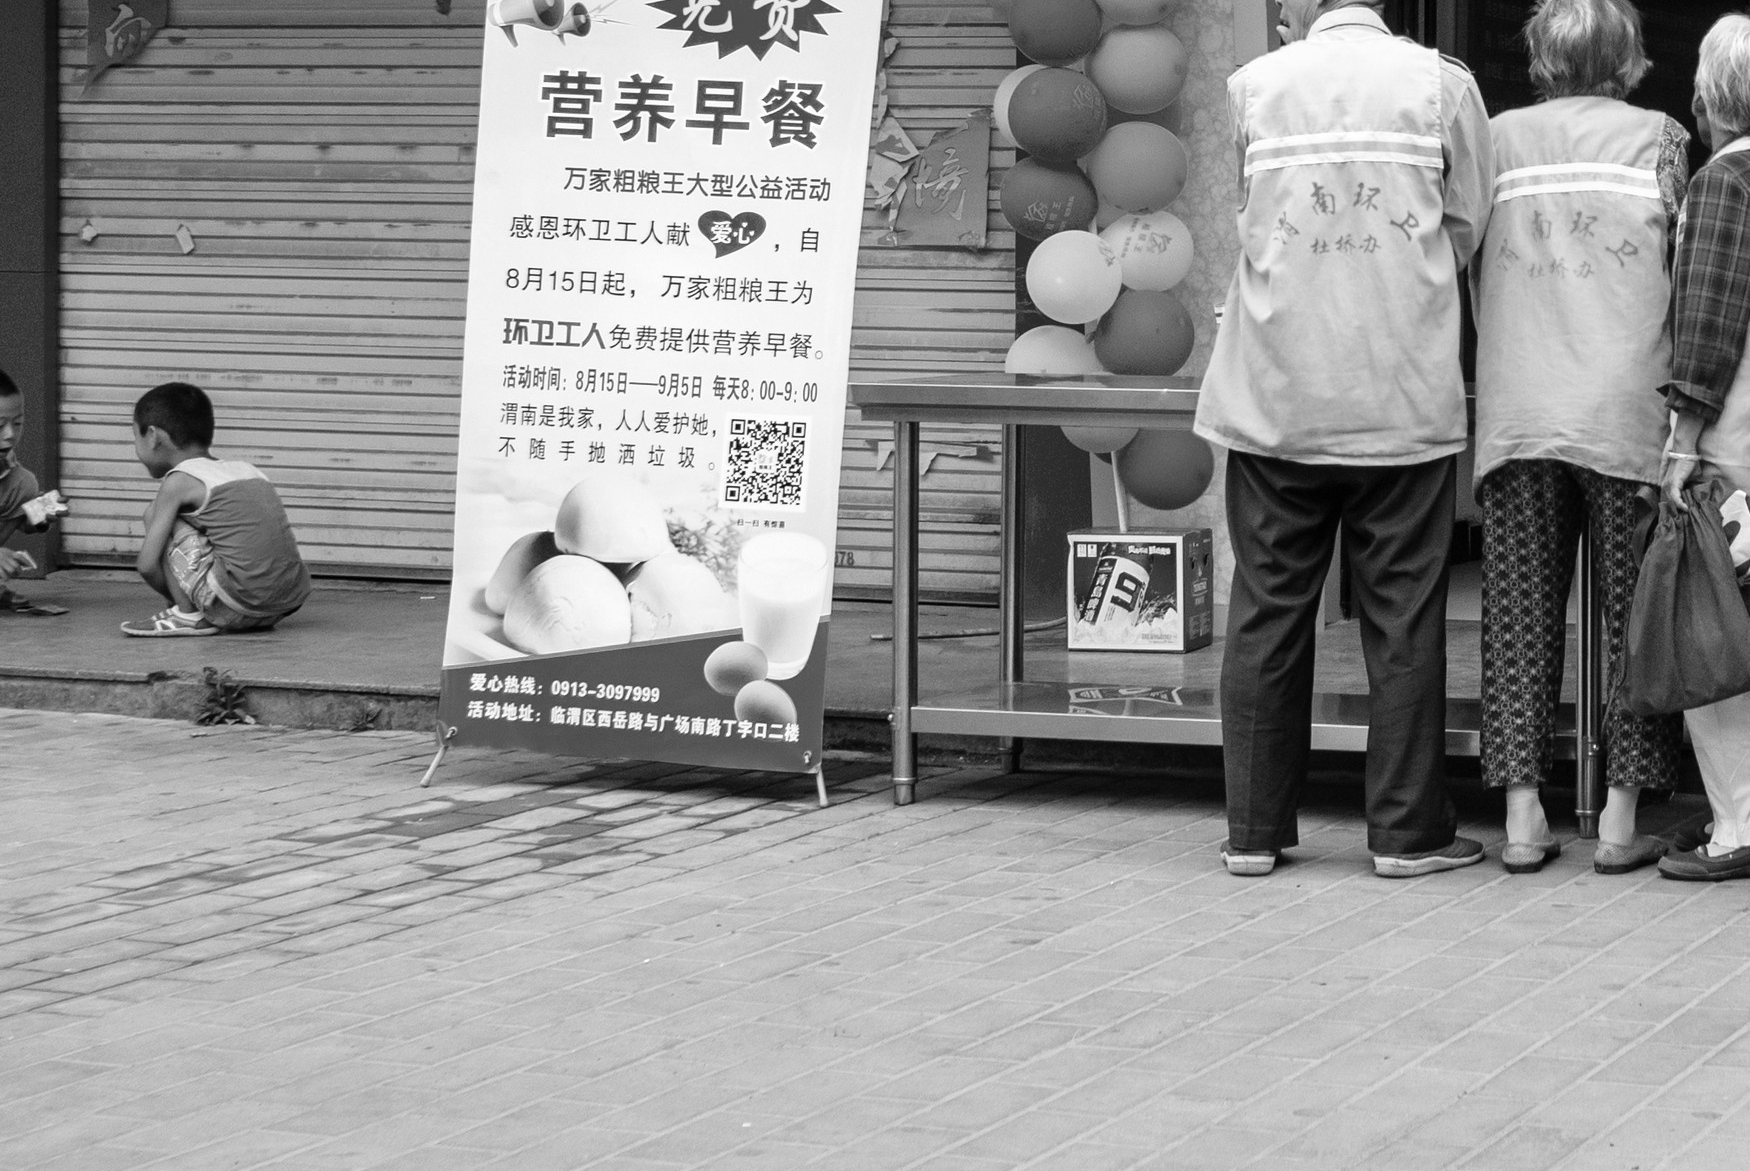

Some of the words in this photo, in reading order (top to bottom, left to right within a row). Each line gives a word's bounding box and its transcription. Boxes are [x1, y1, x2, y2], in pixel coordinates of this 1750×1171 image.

[540, 70, 826, 151] 营养早餐
[563, 166, 832, 203] 万家粗粮王大型公益活动
[509, 214, 691, 248] 感恩环卫工人献
[710, 220, 756, 246] 爱心
[502, 317, 824, 361] 环卫工人免费提供营养早餐。
[469, 672, 661, 704] 爱心热线：0913-3097999
